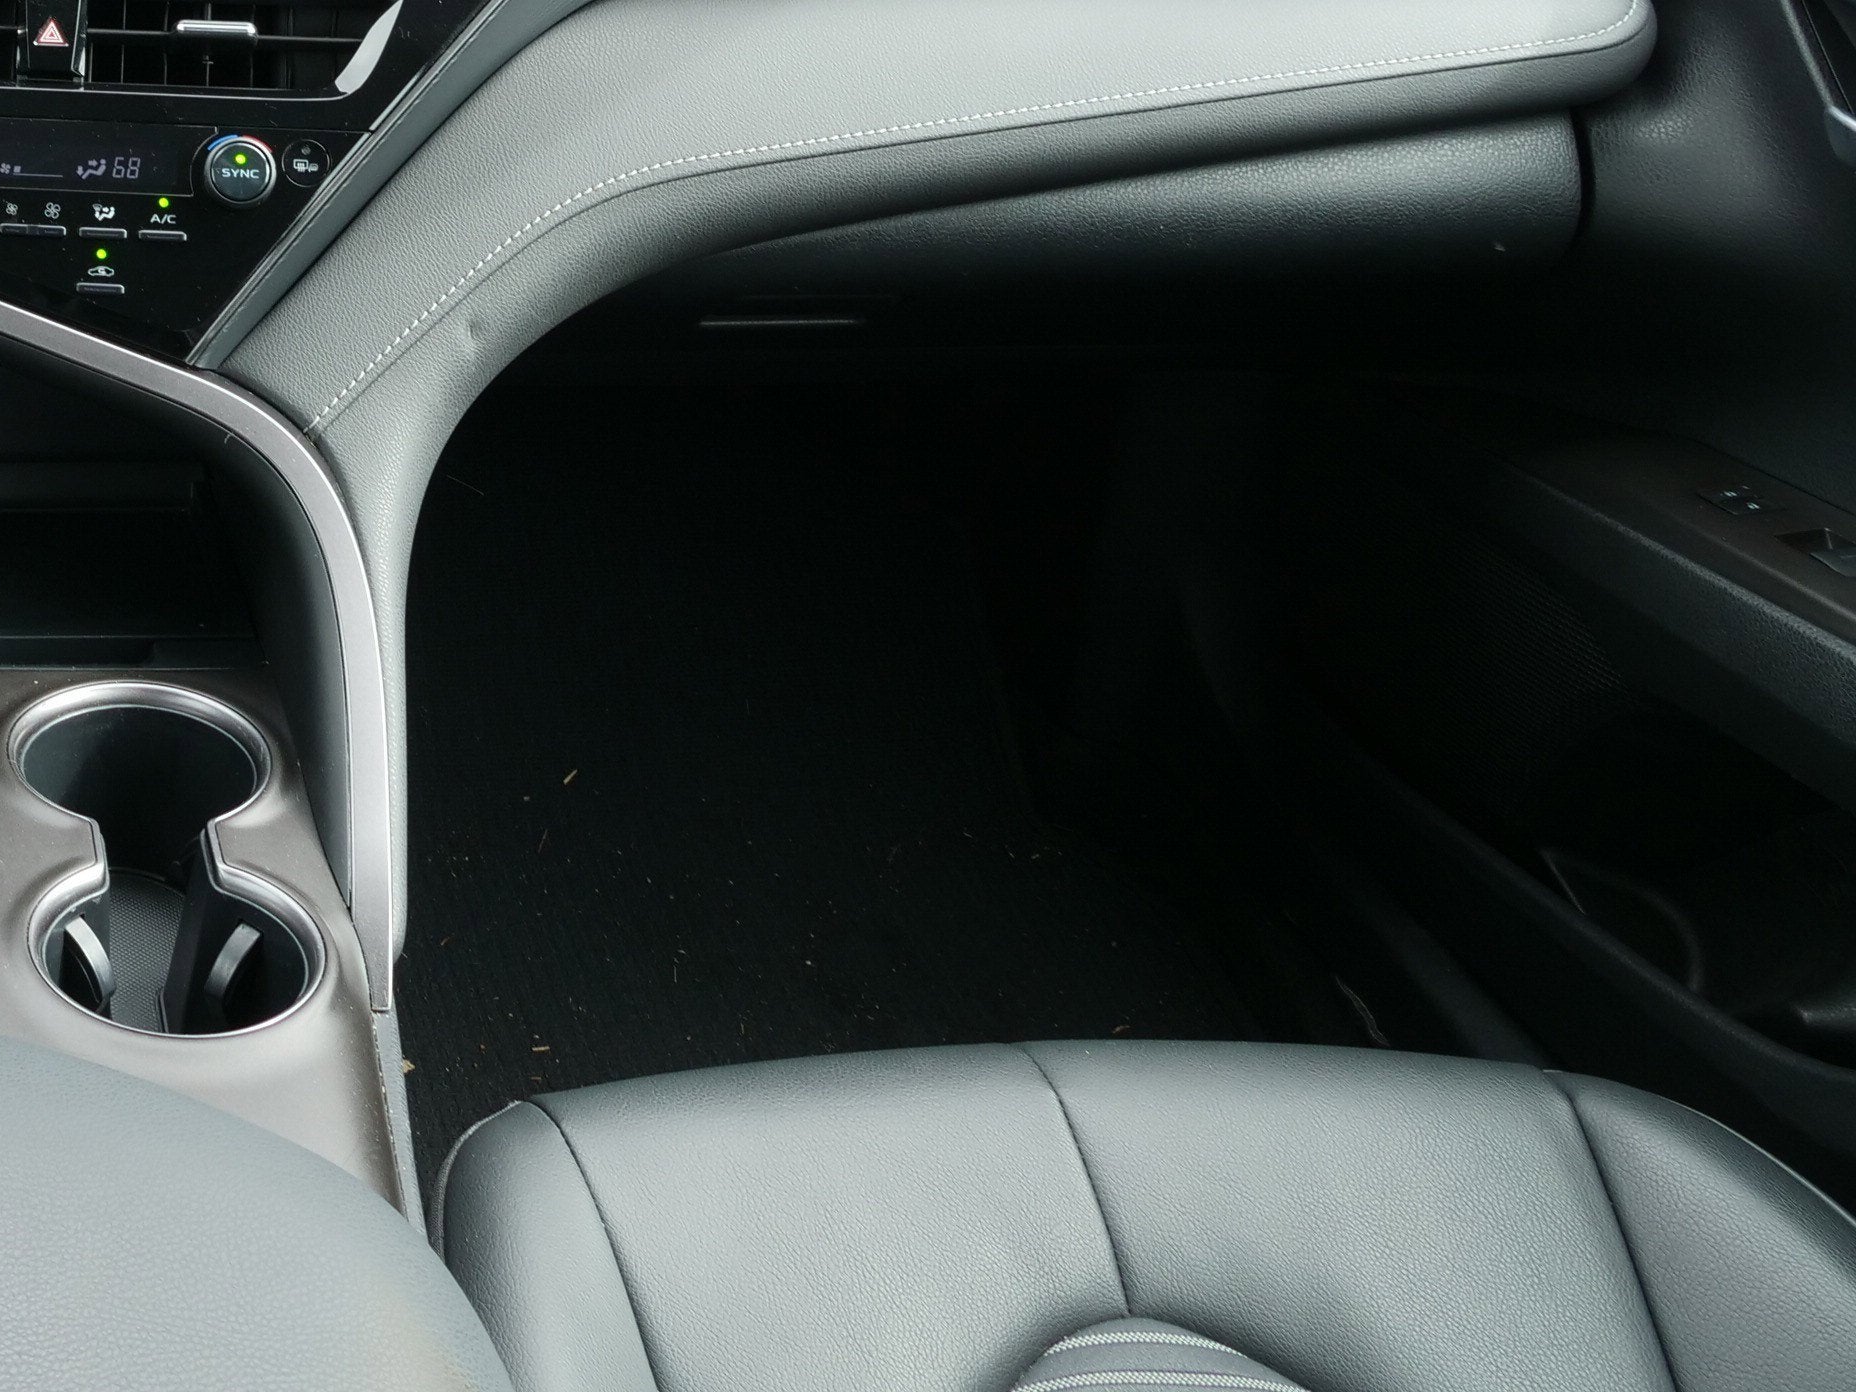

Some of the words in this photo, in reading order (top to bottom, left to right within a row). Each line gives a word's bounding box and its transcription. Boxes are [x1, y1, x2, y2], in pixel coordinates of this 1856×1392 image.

[112, 157, 141, 180] 68
[221, 168, 260, 179] SYNC
[150, 214, 177, 224] A/C
